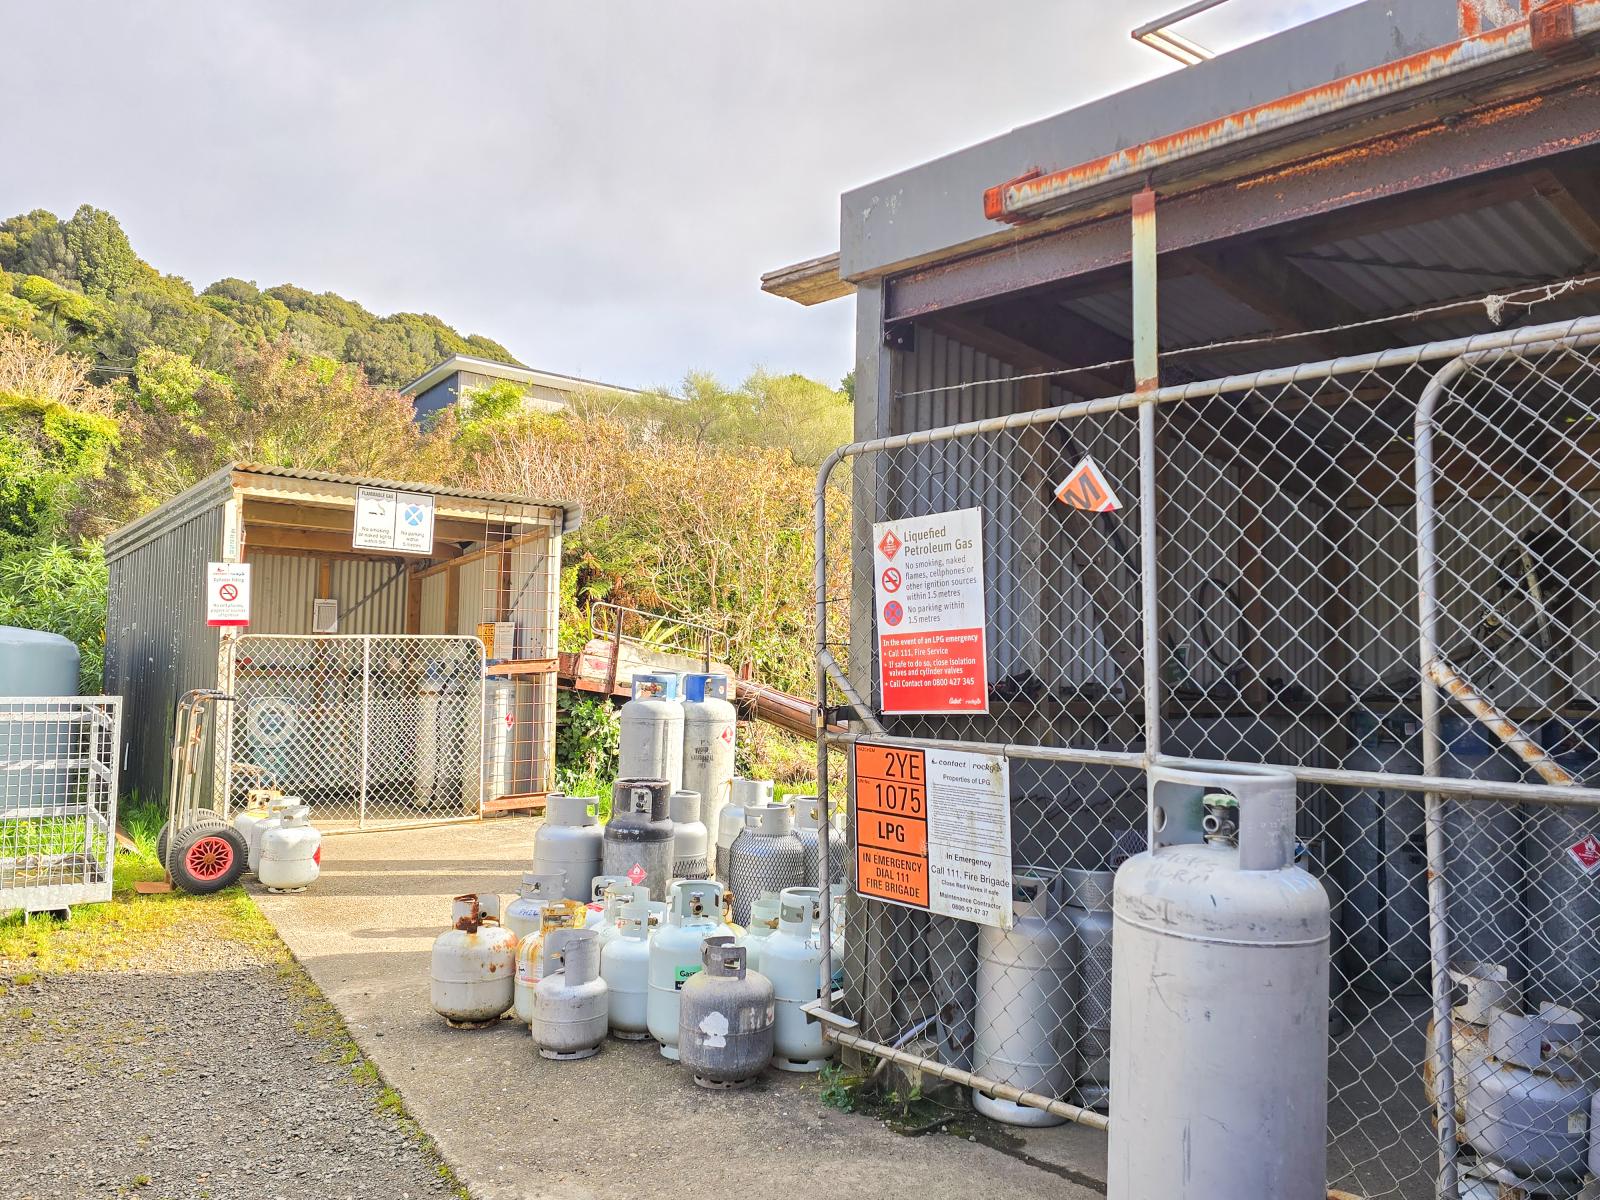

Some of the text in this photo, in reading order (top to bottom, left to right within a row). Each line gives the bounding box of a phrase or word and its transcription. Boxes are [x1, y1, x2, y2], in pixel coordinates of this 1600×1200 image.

[904, 526, 946, 543] Liquefied
[905, 542, 952, 557] Petroleum
[955, 539, 973, 550] Gas
[905, 555, 966, 570] No smoking, naked
[906, 571, 928, 580] flames,
[930, 567, 965, 579] cellphones
[906, 577, 977, 591] other ignition sources
[907, 590, 961, 601] within 1.5 metres
[908, 601, 965, 613] No parking within
[908, 615, 941, 624] 1.5 metres
[900, 638, 917, 646] event
[945, 634, 978, 643] emergency
[888, 649, 900, 658] Call
[914, 648, 926, 656] Fire
[889, 669, 907, 677] valves
[908, 668, 918, 676] and
[920, 668, 943, 677] cylinder
[890, 680, 901, 688] Call
[902, 679, 923, 687] Contact
[933, 678, 948, 686] 0800
[949, 678, 961, 686] 427
[885, 753, 920, 780] 2YE
[939, 759, 966, 768] contact
[943, 774, 970, 784] Properties
[876, 784, 921, 813] 1075
[878, 821, 905, 842] LPG
[863, 853, 922, 873] IN EMERGENCY
[955, 854, 992, 869] Emergency
[877, 868, 909, 883] DIAL 111
[931, 865, 944, 875] Call
[964, 872, 978, 881] Fire
[981, 875, 1010, 887] Brigade
[866, 878, 920, 898] FIRE BRIGADE
[967, 885, 983, 893] Valves
[940, 892, 1001, 910] Maintenance Contractor
